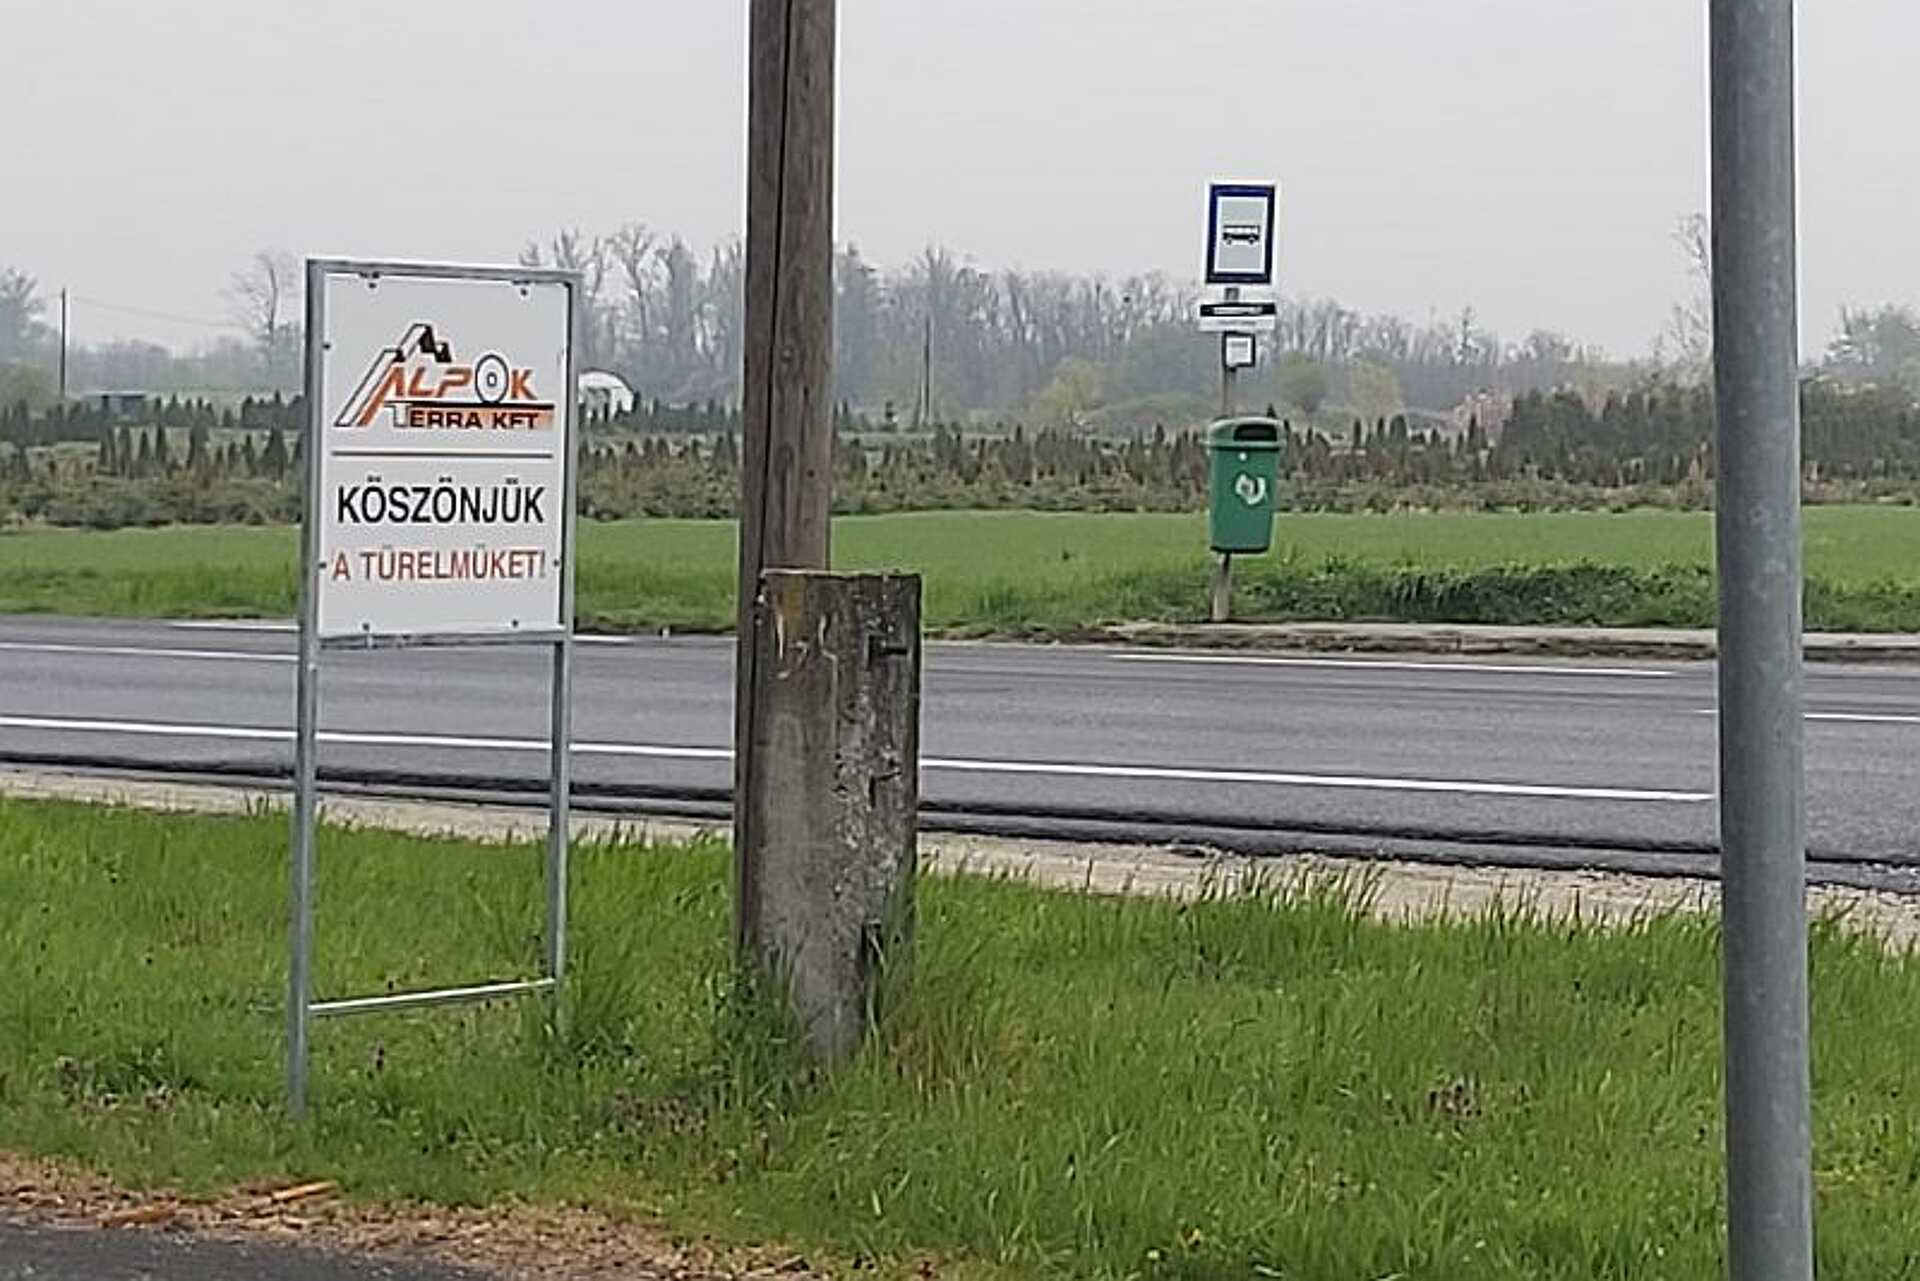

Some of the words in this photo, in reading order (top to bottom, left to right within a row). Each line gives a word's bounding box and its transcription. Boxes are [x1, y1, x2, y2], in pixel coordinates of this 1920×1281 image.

[357, 354, 537, 427] ALPOK
[386, 403, 482, 429] TERRA
[492, 411, 540, 430] KFT
[337, 476, 545, 523] KÖSZÖNJÜK
[332, 552, 351, 580] A
[360, 543, 546, 580] TÜRELMÜKET!
